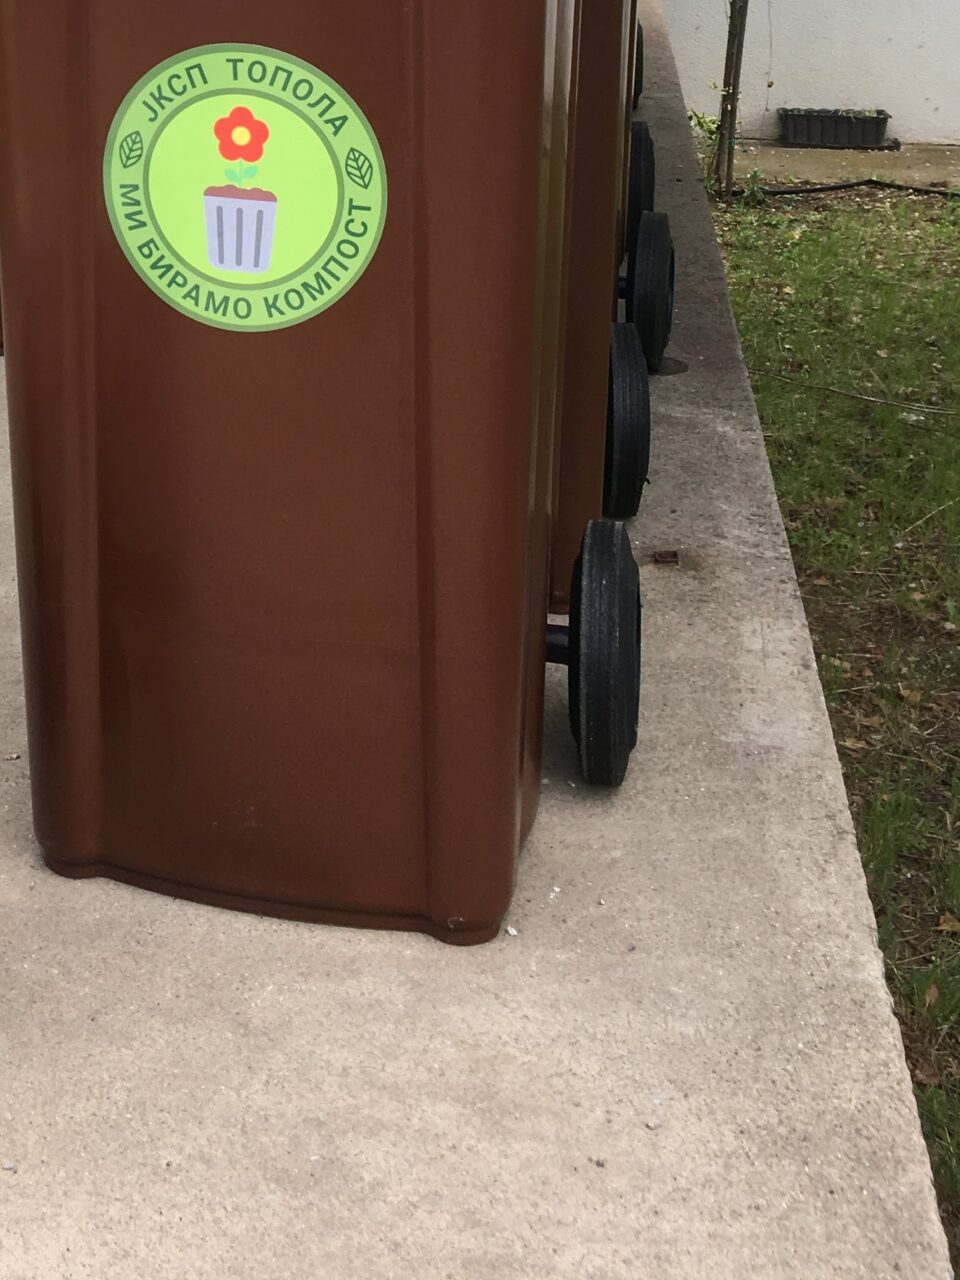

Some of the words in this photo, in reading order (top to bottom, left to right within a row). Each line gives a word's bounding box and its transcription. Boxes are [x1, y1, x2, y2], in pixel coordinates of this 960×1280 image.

[142, 63, 209, 123] ЈКСП
[226, 58, 349, 137] ТОПОЛА
[119, 183, 147, 231] МИ
[137, 237, 252, 320] БИРАМО
[263, 198, 372, 318] КОМПОСТ
